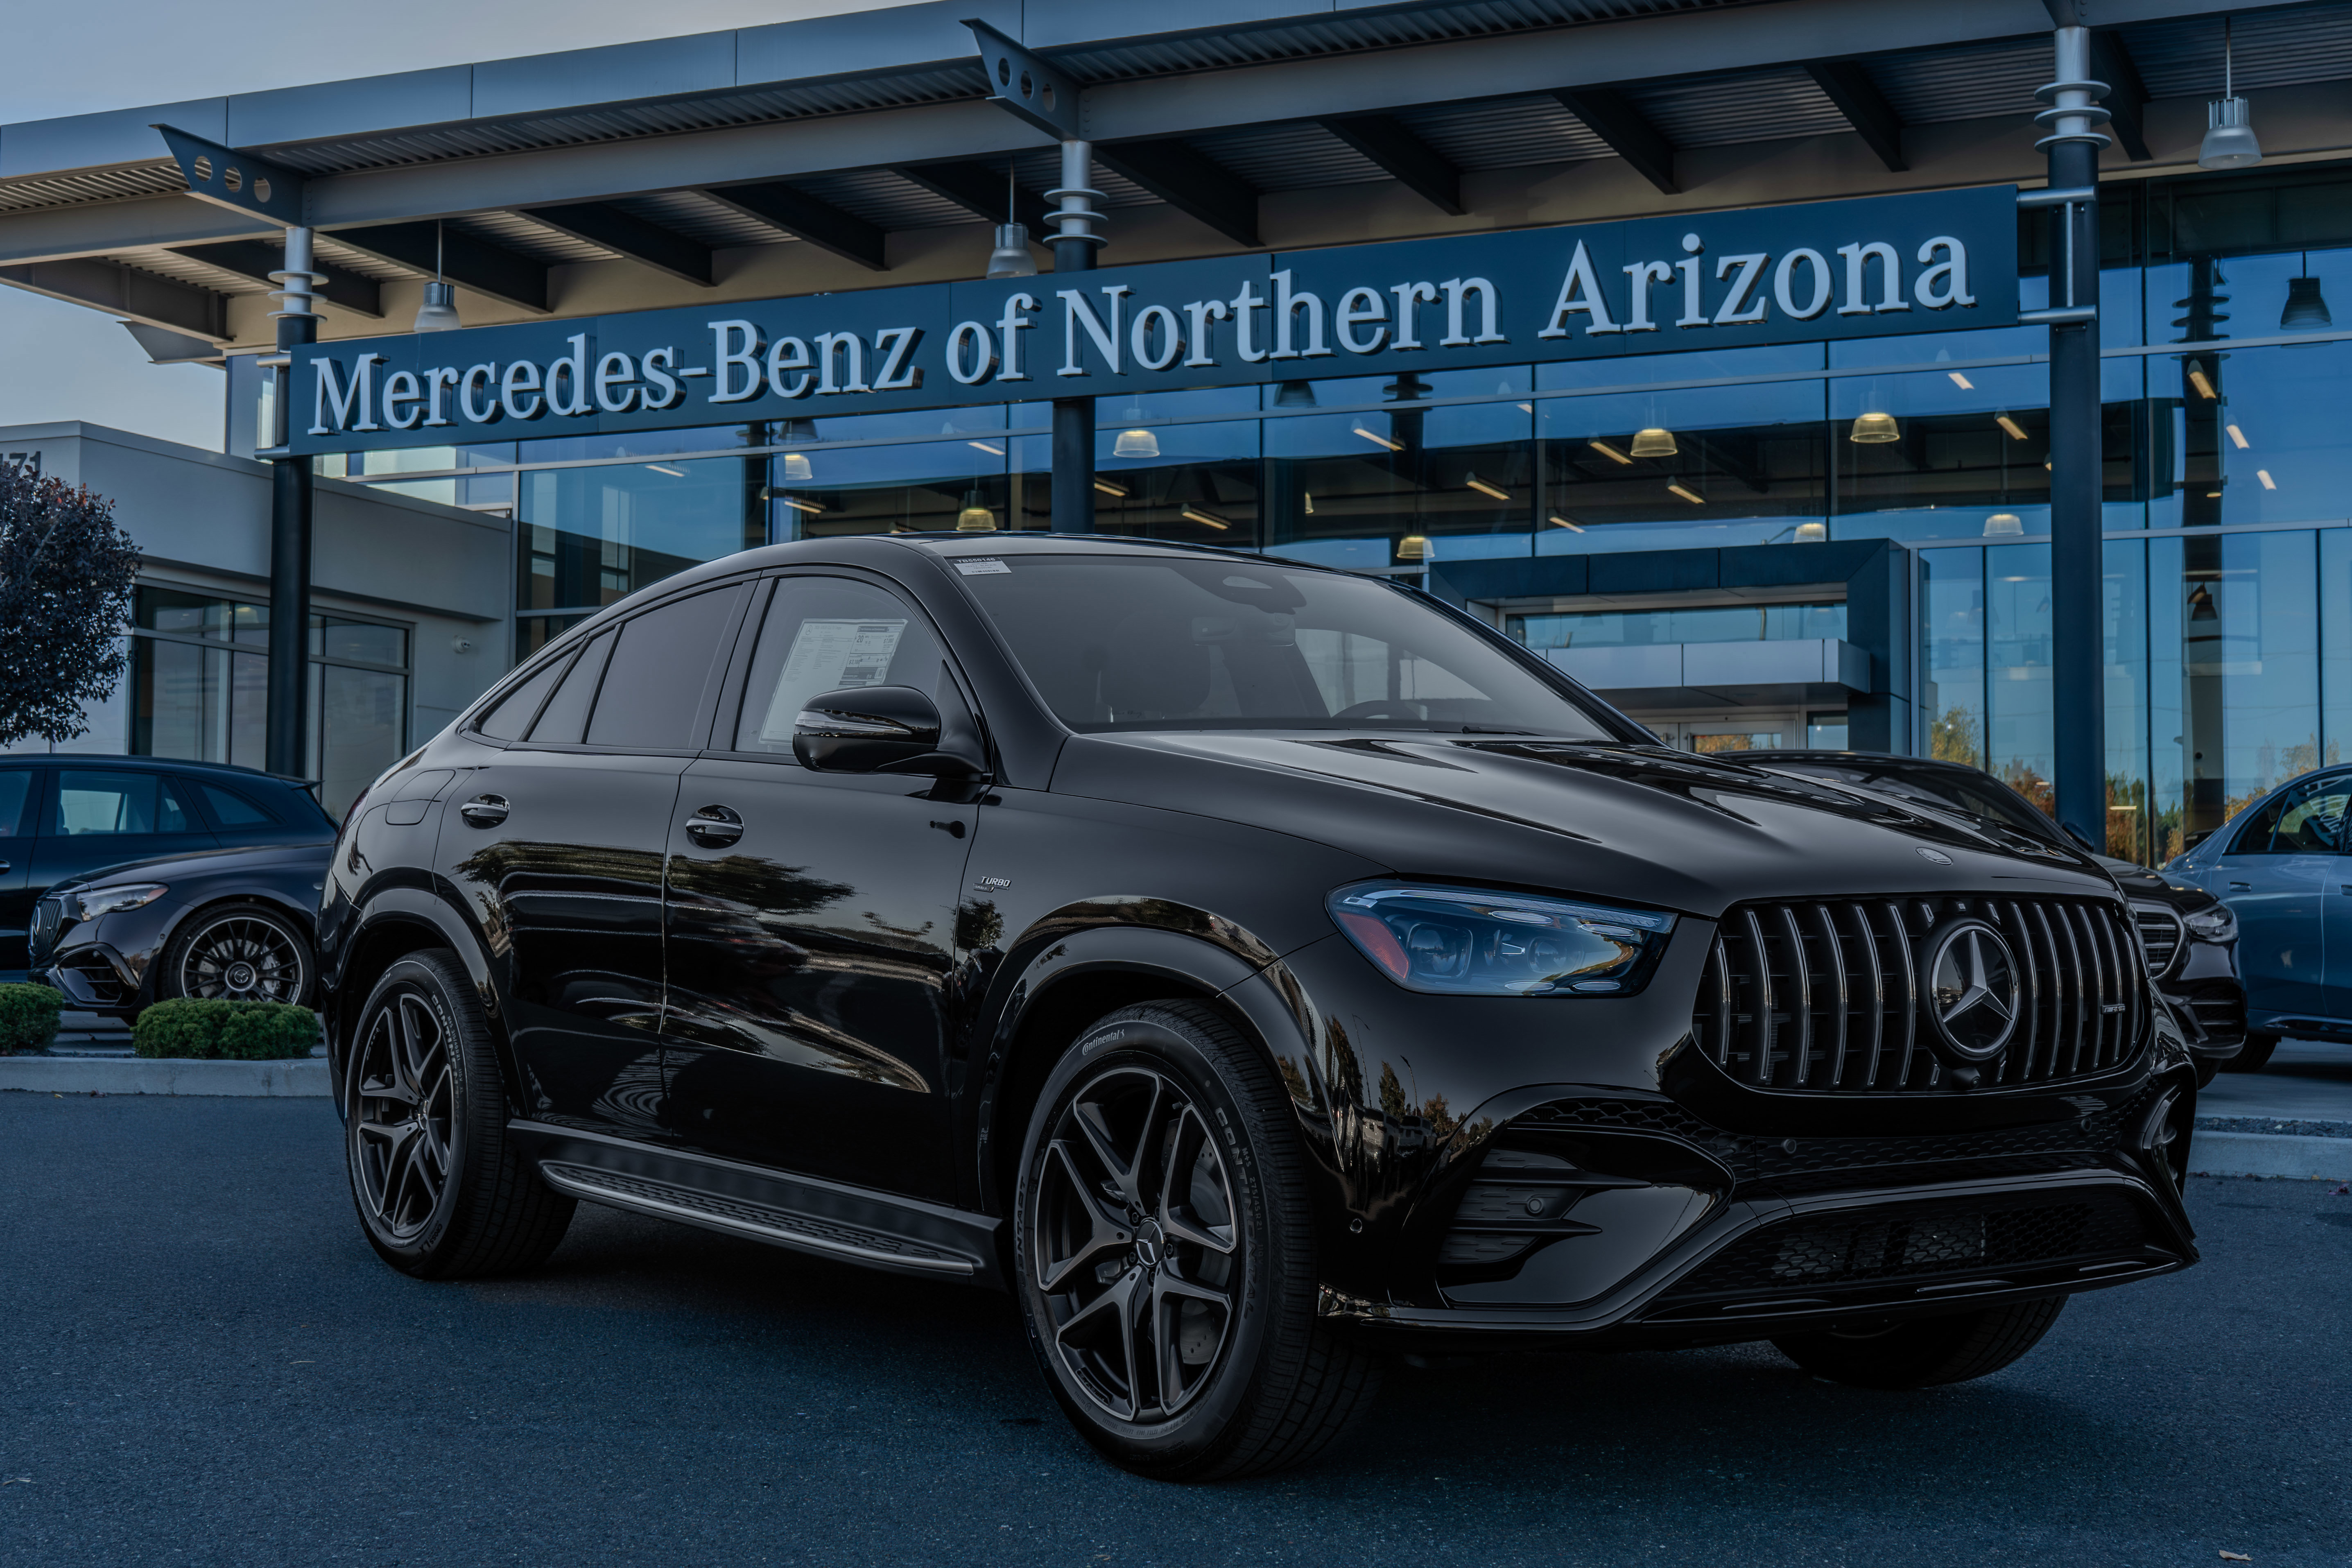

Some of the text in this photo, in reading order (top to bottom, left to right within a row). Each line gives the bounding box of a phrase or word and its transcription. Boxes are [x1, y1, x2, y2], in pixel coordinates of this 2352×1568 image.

[308, 234, 1975, 435] Mercedes-Benz of Northern Arizona
[0, 451, 41, 482] 71
[981, 876, 1011, 887] TURBO
[1082, 1029, 1120, 1056] Continental
[1242, 1147, 1252, 1167] M+S
[1215, 1107, 1257, 1319] CONTINENTAL
